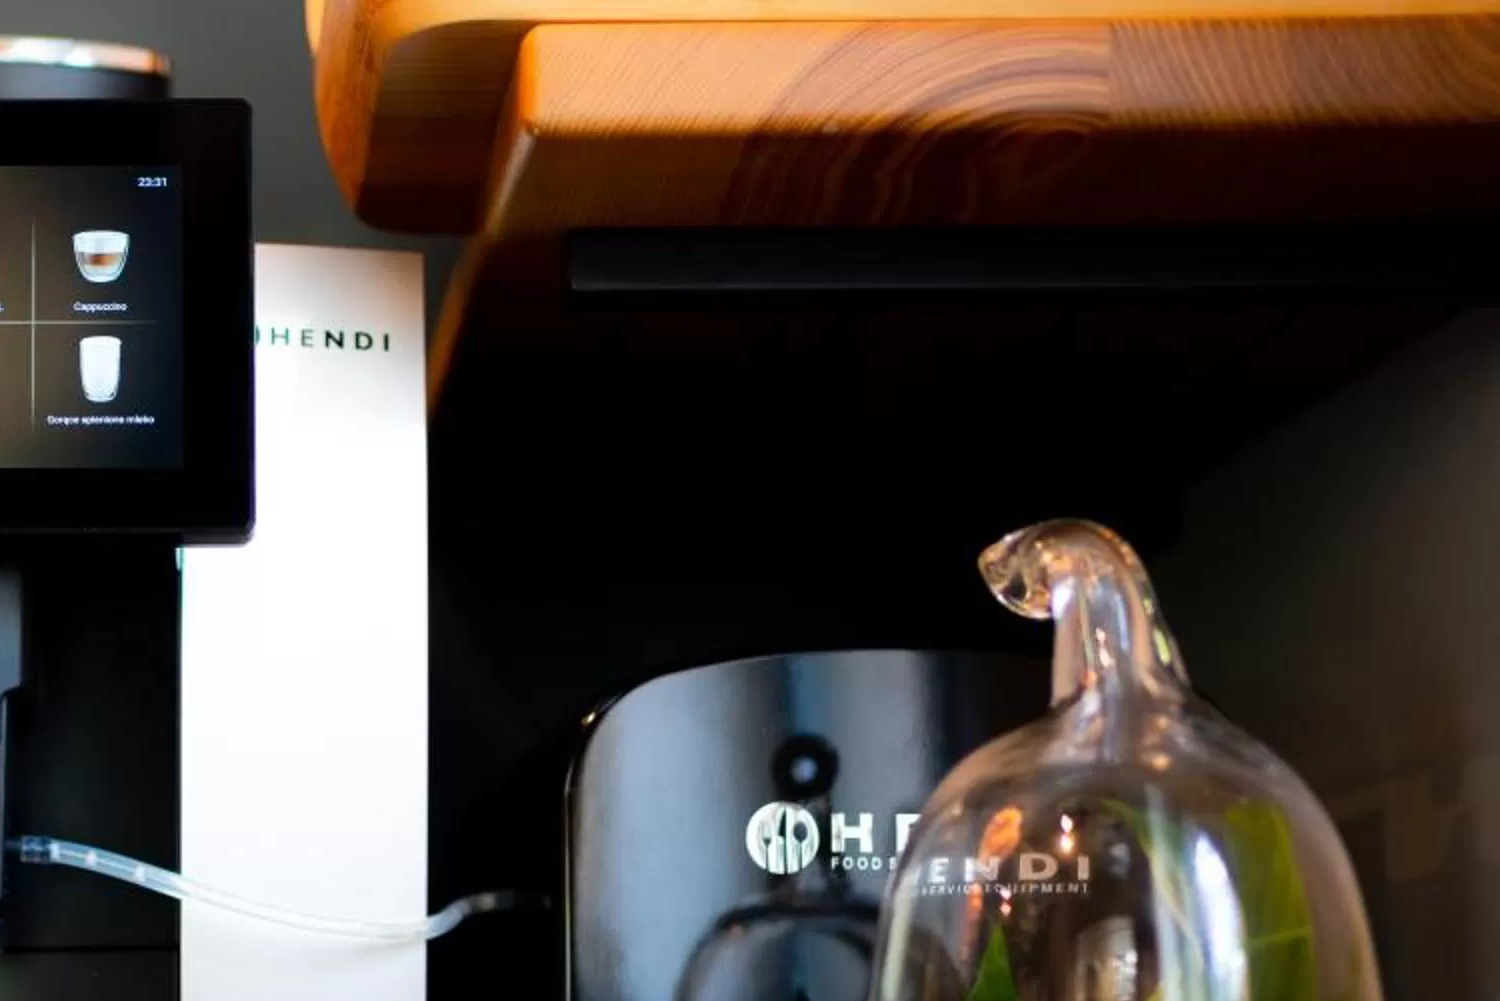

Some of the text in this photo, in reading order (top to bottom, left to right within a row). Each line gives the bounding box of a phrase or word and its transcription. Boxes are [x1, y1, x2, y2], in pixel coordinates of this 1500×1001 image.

[73, 302, 128, 313] Cappuccino
[270, 327, 389, 351] HENDI
[831, 856, 882, 870] FOOD
